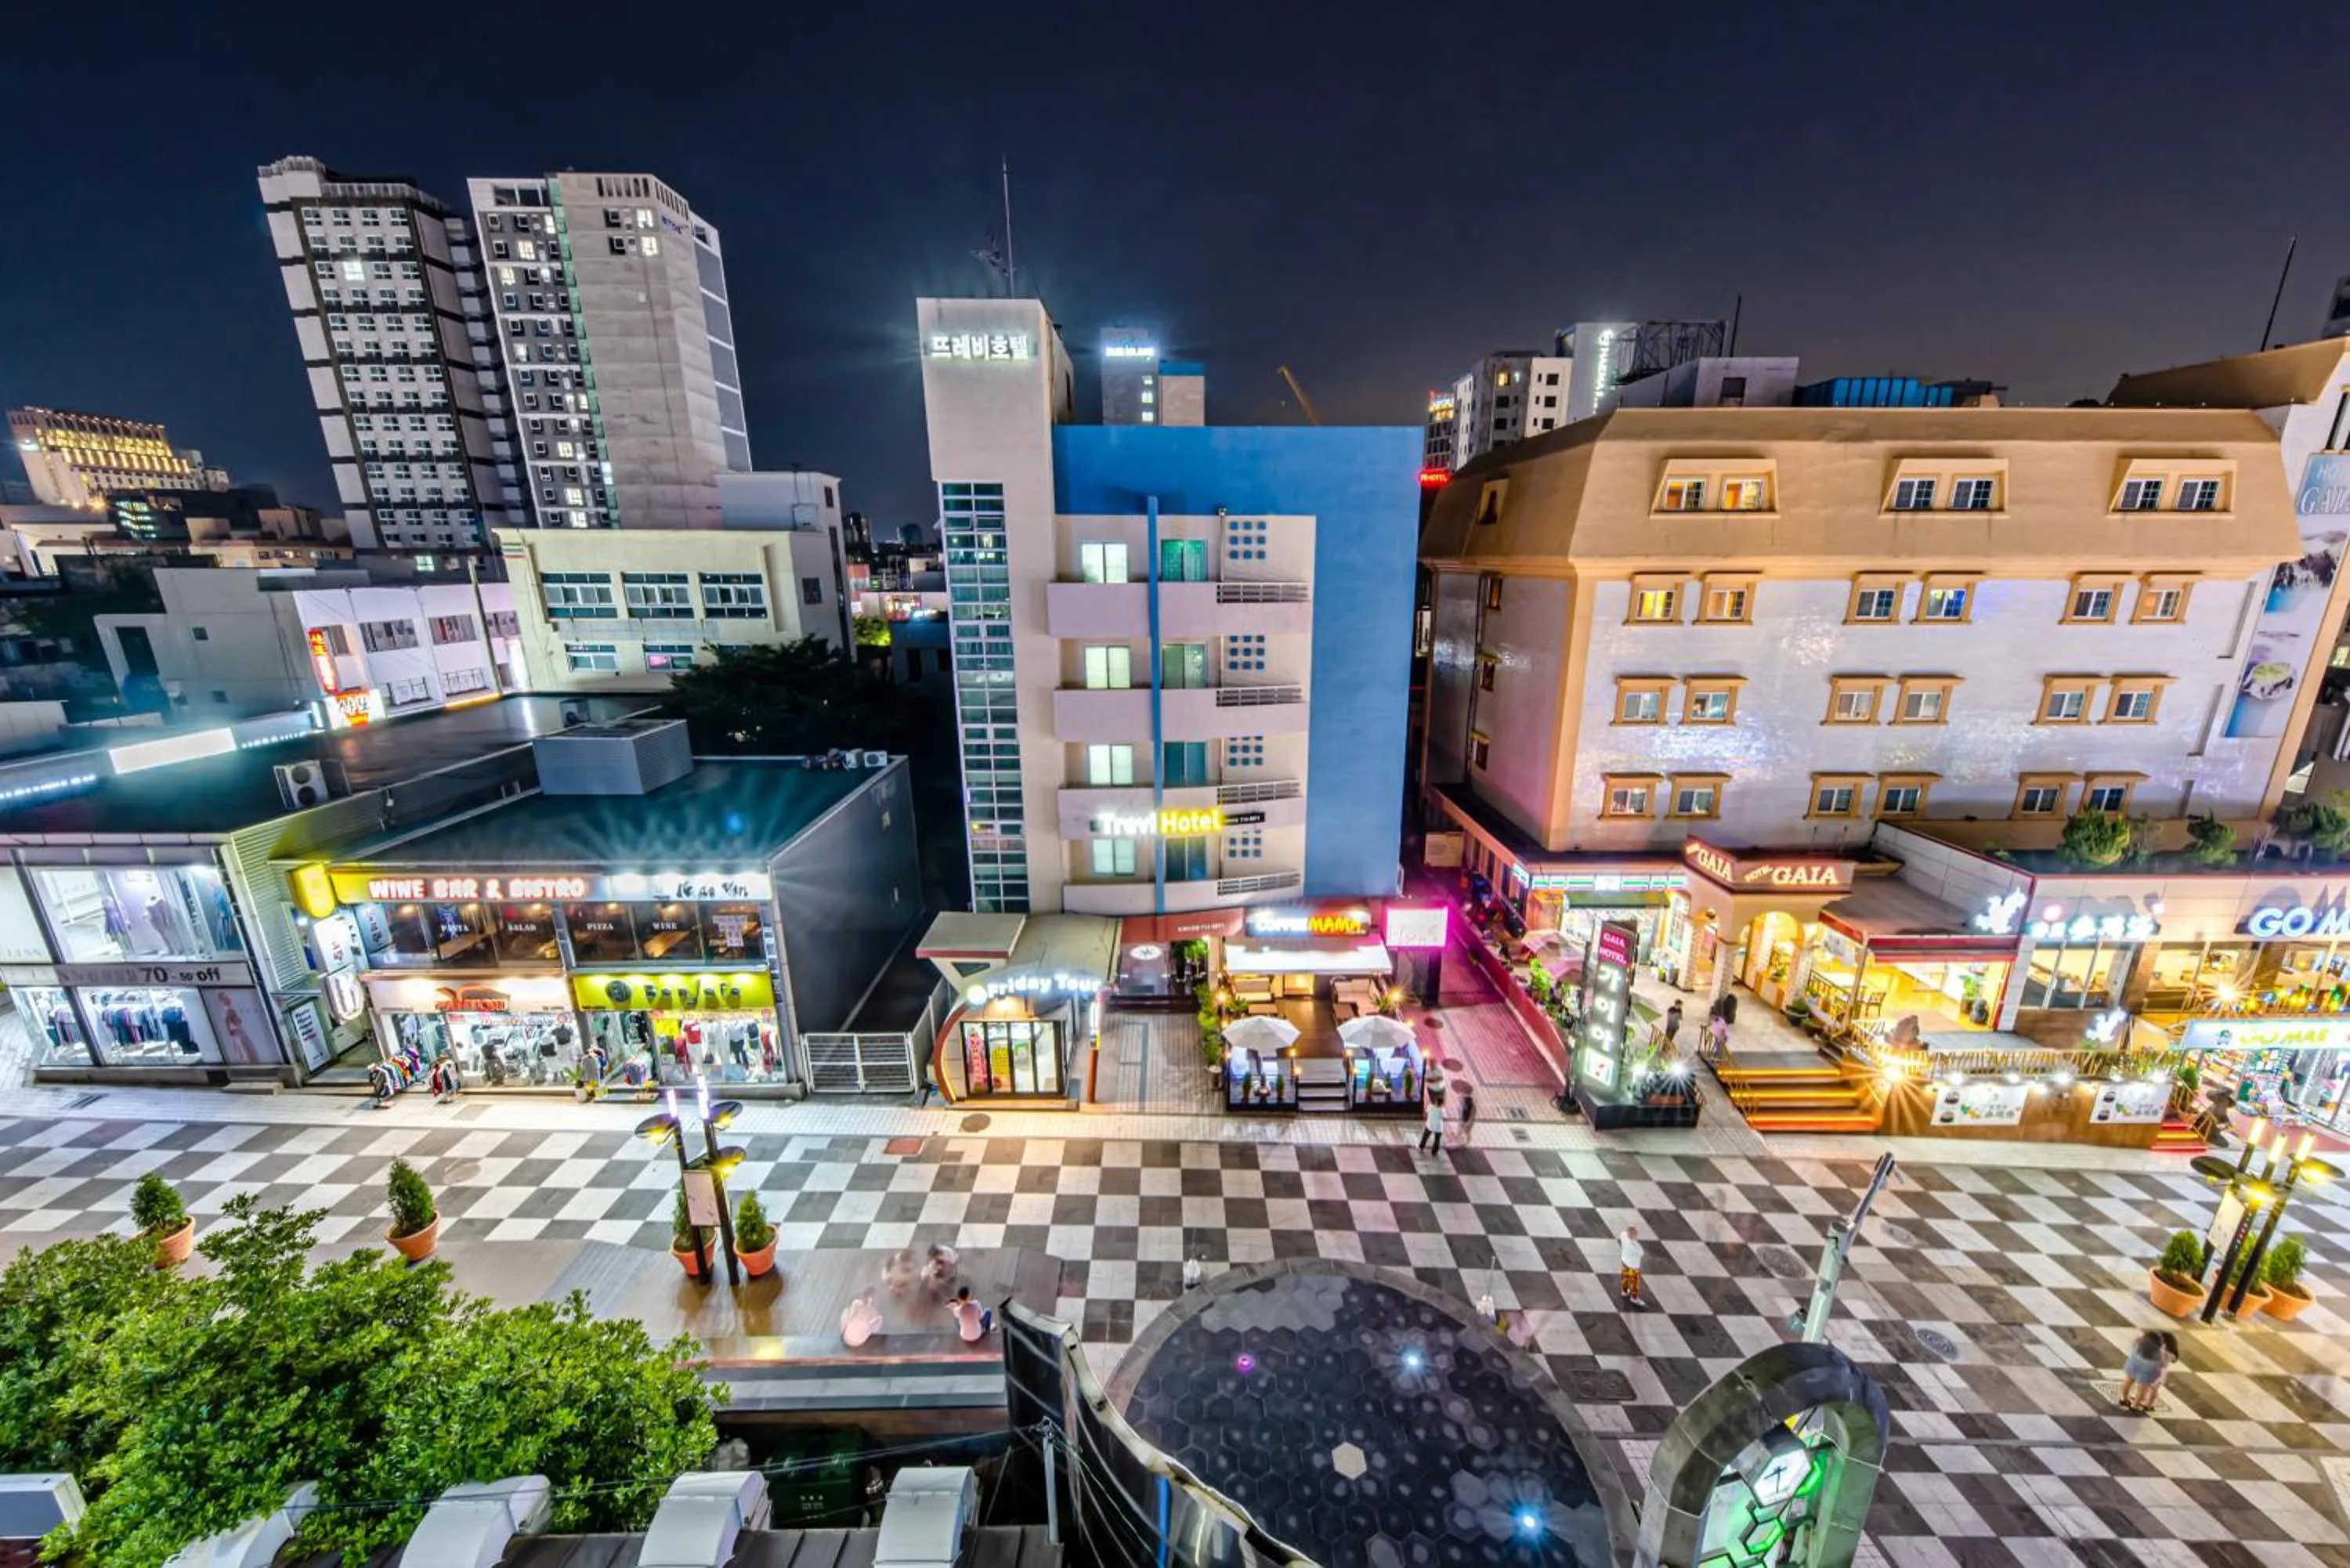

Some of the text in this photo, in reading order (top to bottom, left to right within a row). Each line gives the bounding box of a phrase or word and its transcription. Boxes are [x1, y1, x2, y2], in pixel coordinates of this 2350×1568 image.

[1160, 807, 1222, 833] Hotel
[1697, 849, 1733, 882] GAIA
[1772, 865, 1839, 885] GAIA
[368, 879, 426, 899] WINE
[433, 878, 479, 899] BAR
[508, 877, 586, 899] BISTRO
[507, 923, 537, 932] SALAD
[587, 922, 614, 931] PIZZA
[653, 922, 678, 930] WINE
[1309, 915, 1361, 934] MAMA
[1603, 931, 1626, 948] GAIA
[139, 966, 168, 982] 70
[987, 974, 1102, 999] Friday Tour
